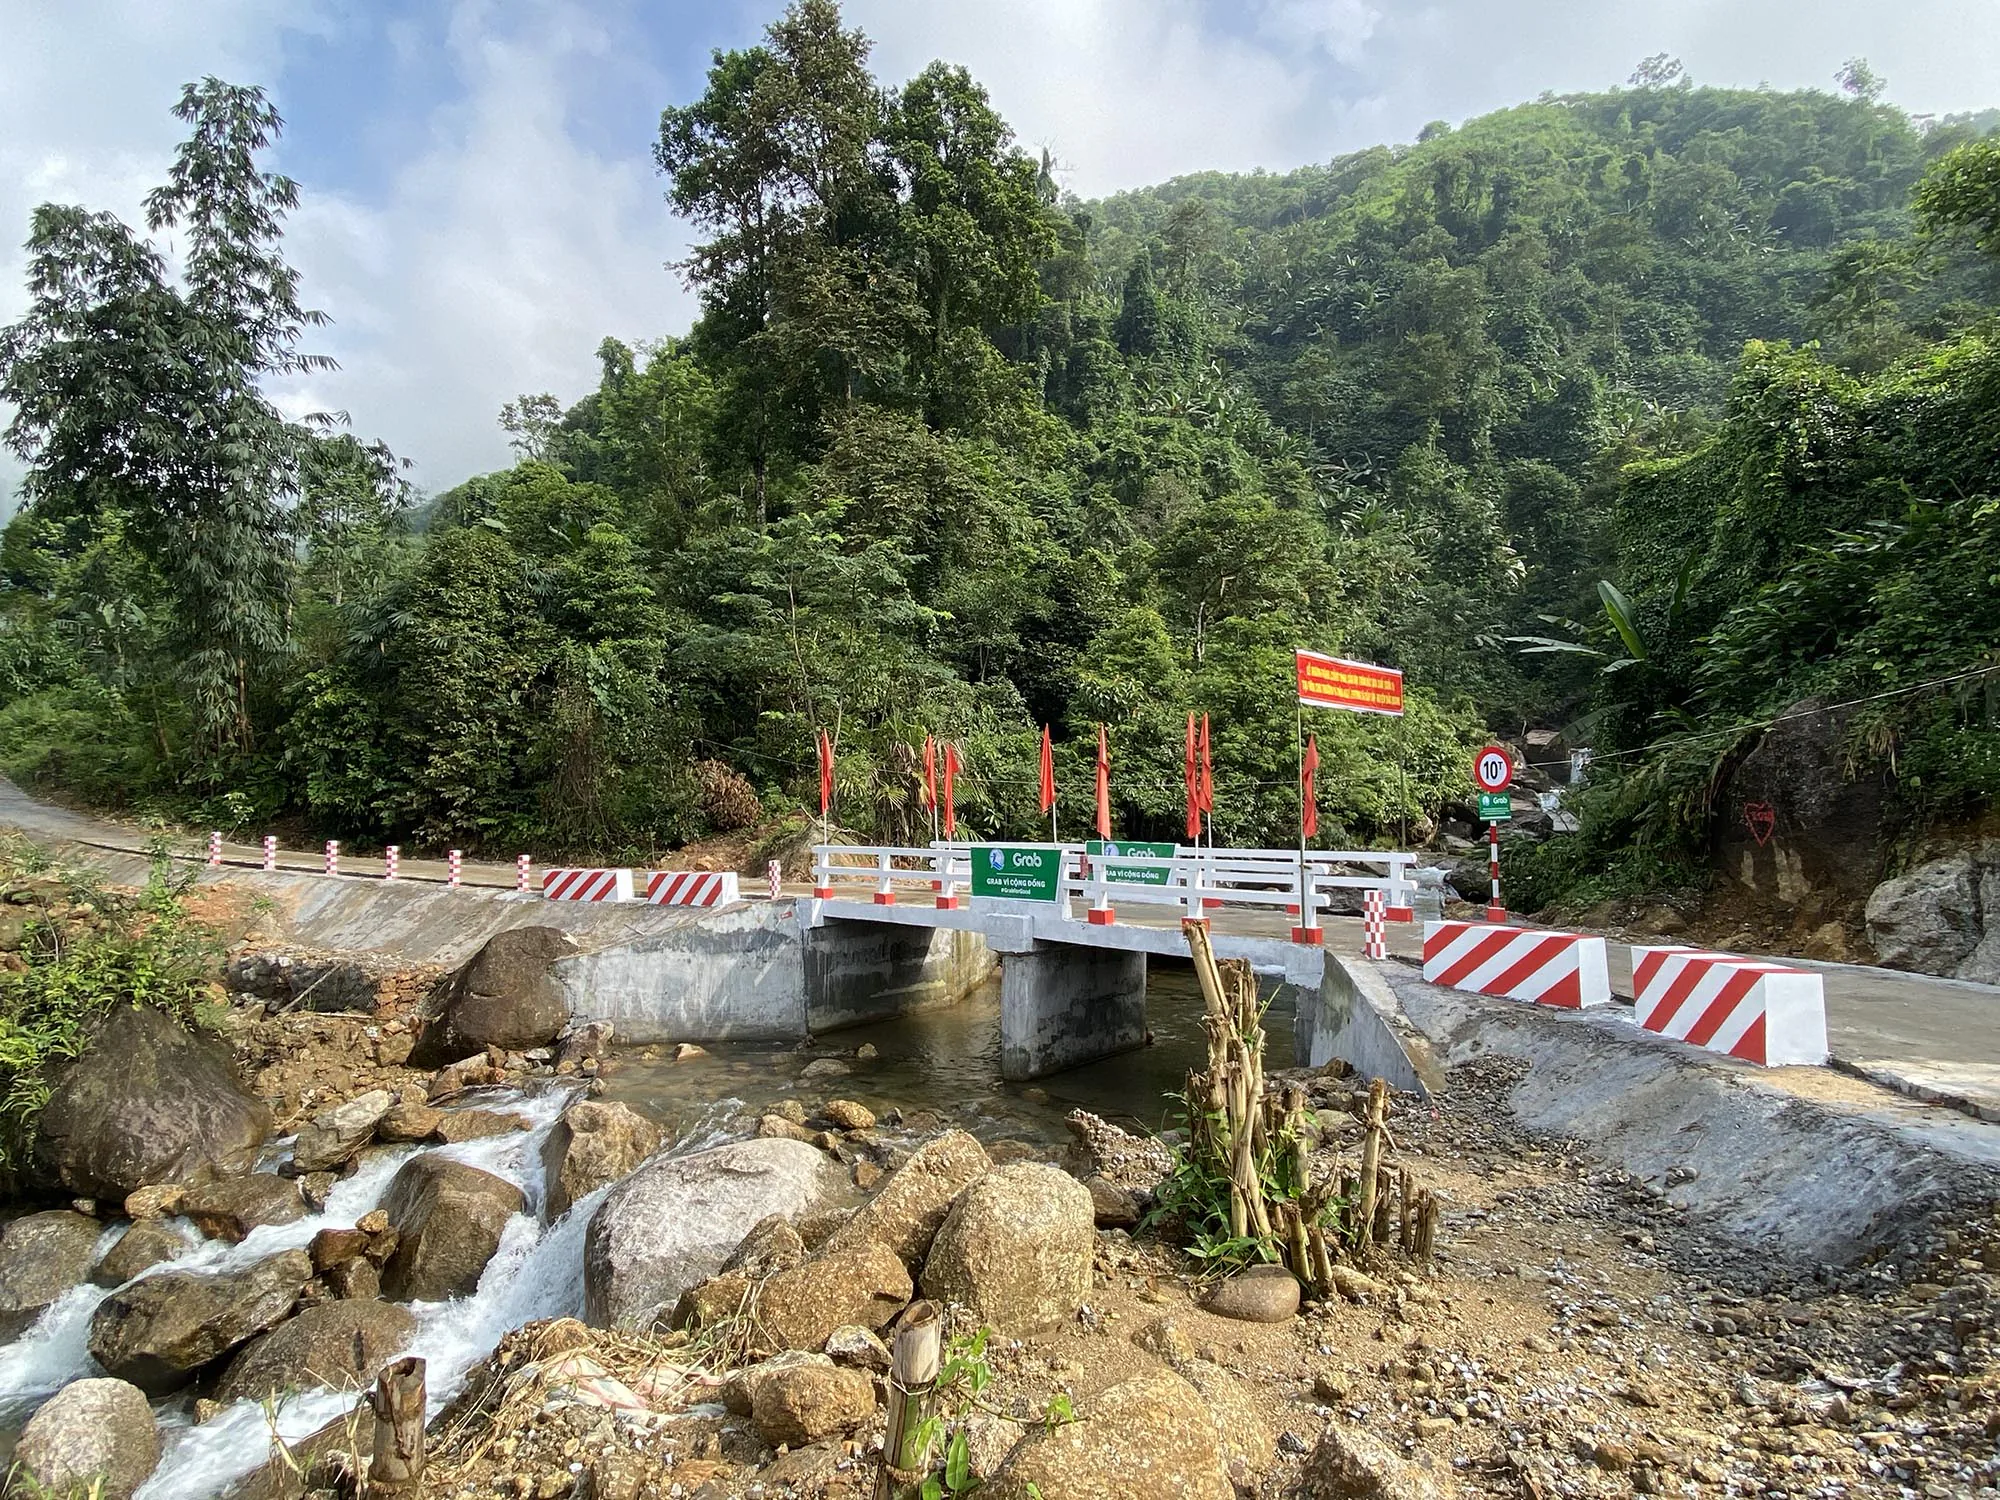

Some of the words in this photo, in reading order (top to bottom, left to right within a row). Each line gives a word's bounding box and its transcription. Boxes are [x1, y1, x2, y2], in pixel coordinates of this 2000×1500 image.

[1492, 796, 1508, 804] Grab
[1127, 848, 1156, 858] Grab
[1012, 852, 1042, 868] Grab
[986, 878, 1002, 886] GRAB
